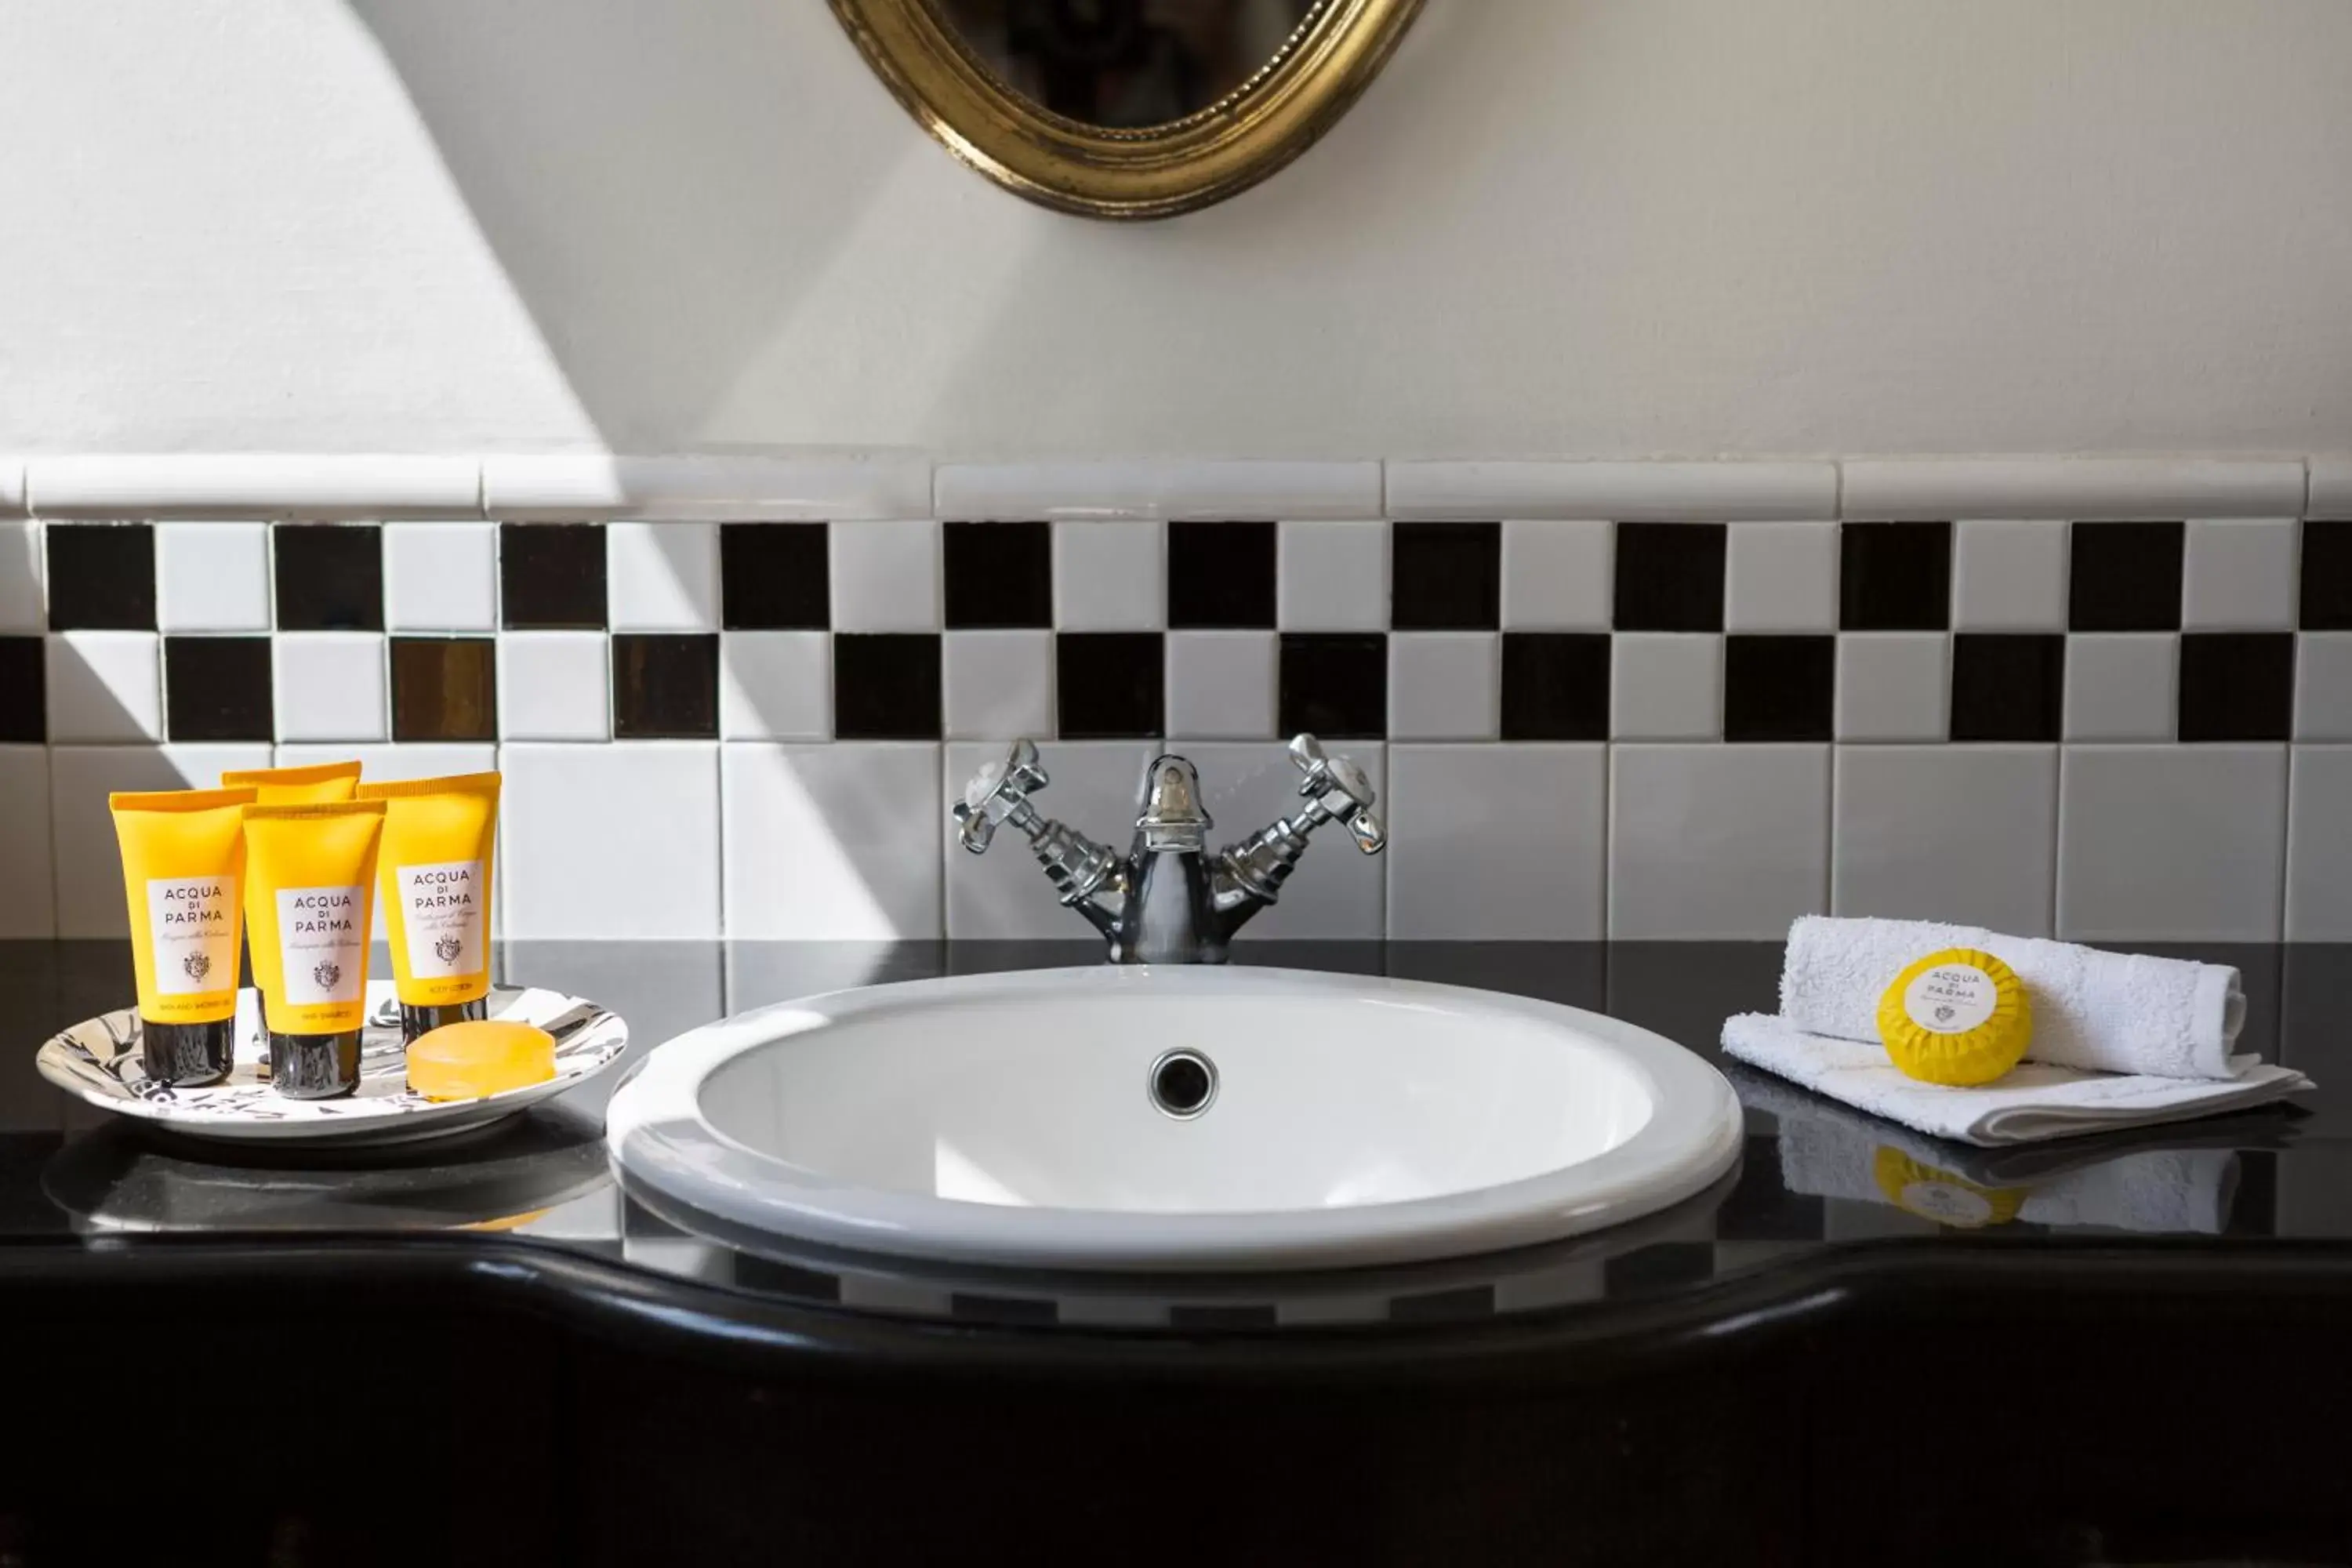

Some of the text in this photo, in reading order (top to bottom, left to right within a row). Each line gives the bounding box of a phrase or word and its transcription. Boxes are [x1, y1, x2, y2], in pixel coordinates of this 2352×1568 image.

[414, 869, 470, 884] ACQUA
[165, 886, 222, 899] ACQUA
[294, 895, 351, 909] ACQUA
[416, 894, 471, 908] PARMA
[165, 910, 223, 924] PARMA
[296, 920, 352, 933] PARMA
[1932, 971, 1980, 983] ACQUA
[1928, 984, 1975, 998] PARMA
